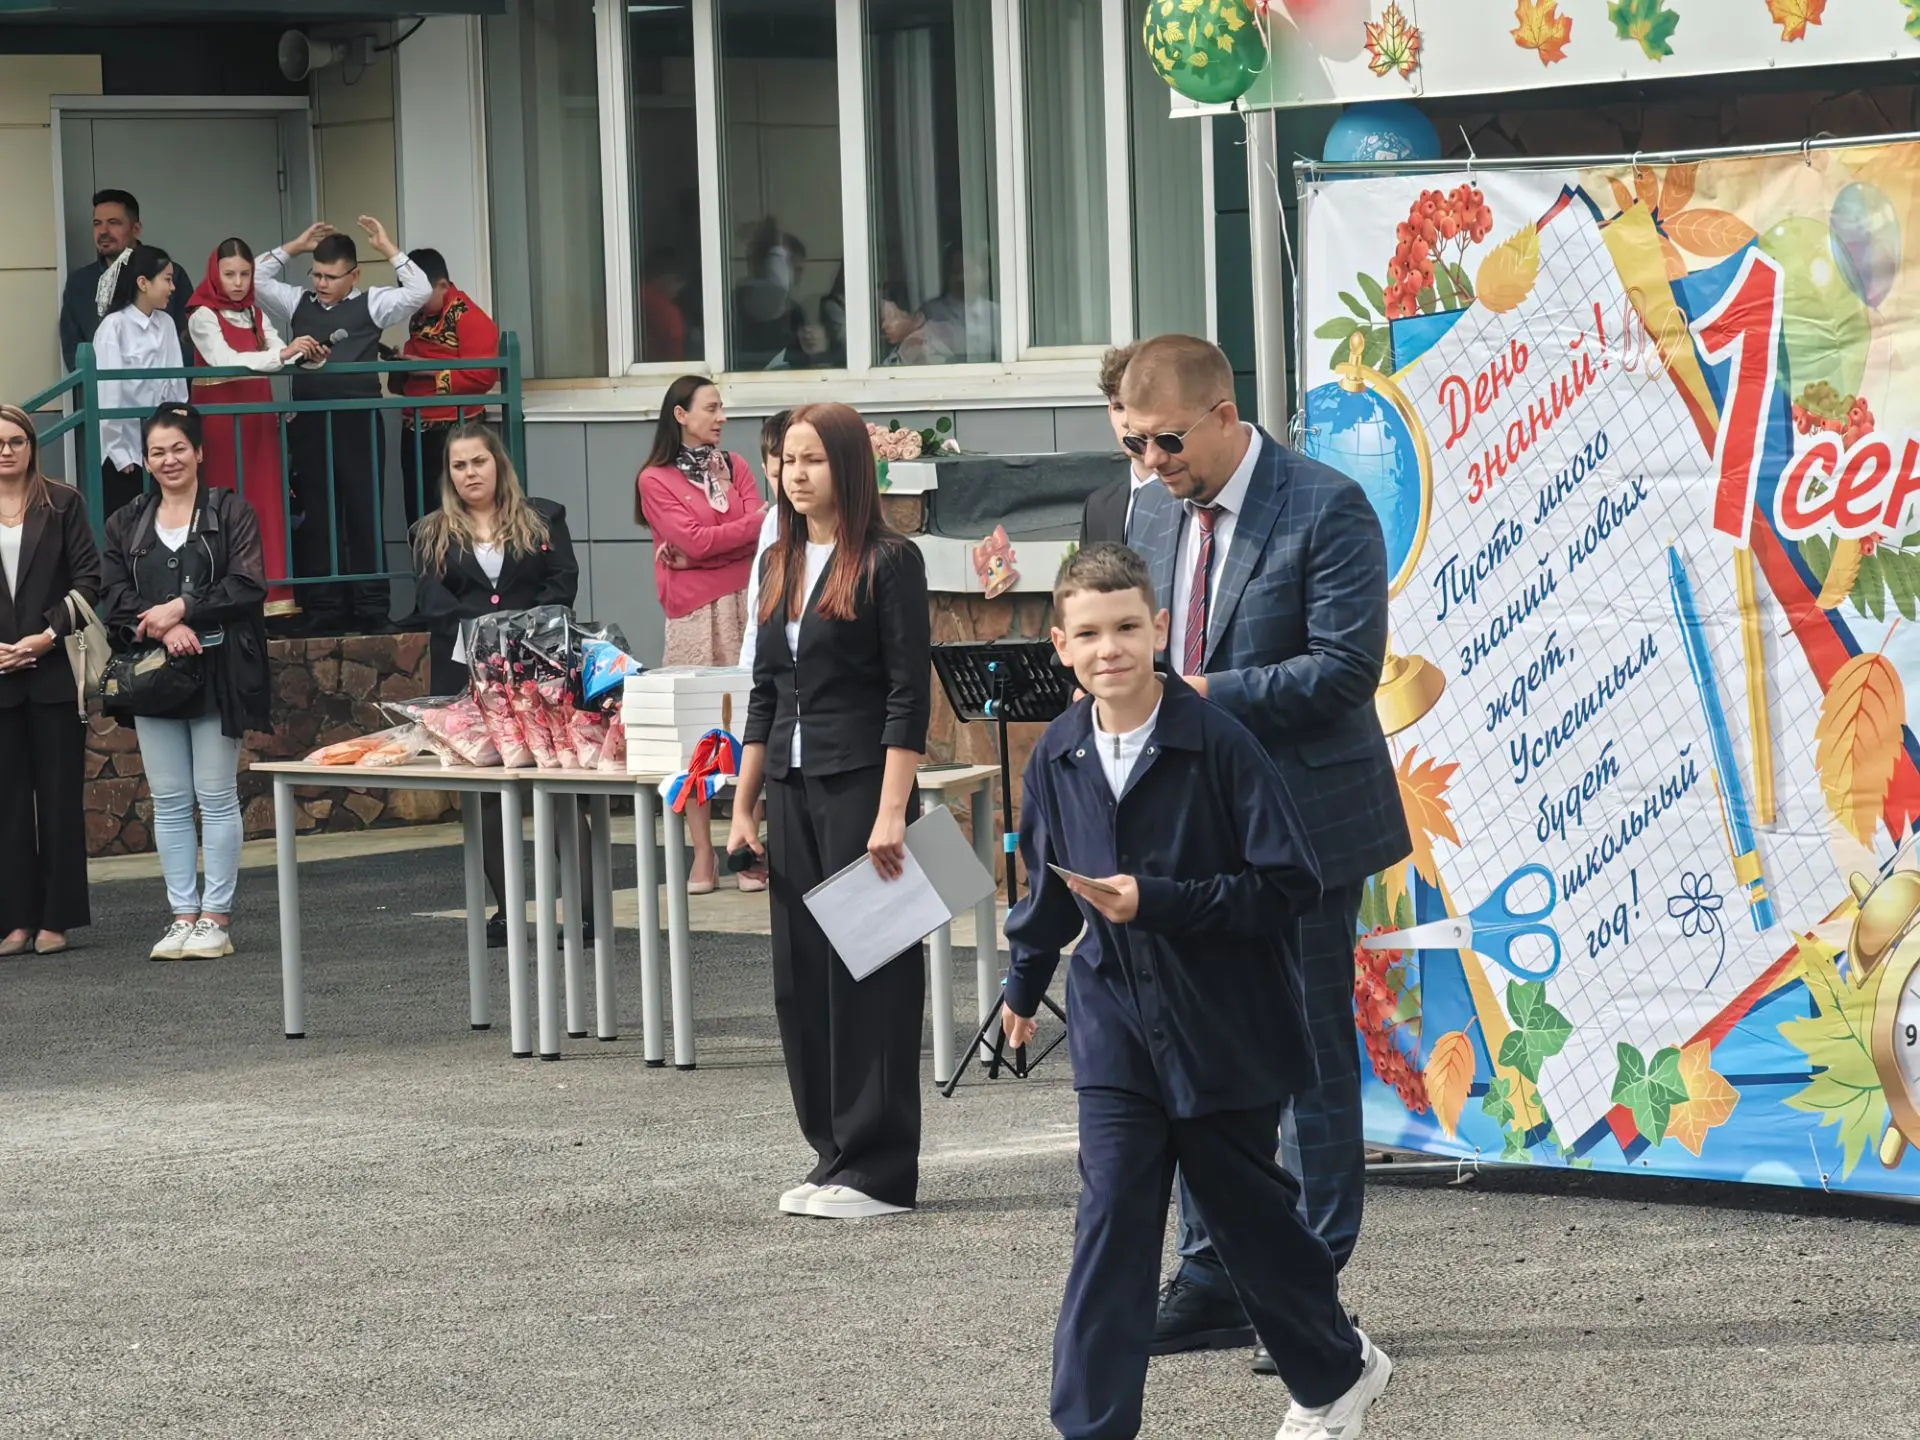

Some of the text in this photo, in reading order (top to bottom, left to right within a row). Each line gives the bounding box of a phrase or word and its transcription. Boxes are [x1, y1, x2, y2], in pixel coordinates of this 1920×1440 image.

[1439, 338, 1529, 450] День
[1468, 302, 1609, 504] знаний!
[1699, 257, 1777, 538] 1
[1433, 430, 1608, 621] Пусть много
[1460, 474, 1648, 676] знаний новых
[1486, 630, 1574, 732] ждет,
[1510, 633, 1658, 784] Успешным
[1536, 739, 1620, 842] будет
[1562, 742, 1699, 901] школьный
[1587, 868, 1640, 959] год!
[1905, 1024, 1918, 1047] 9
